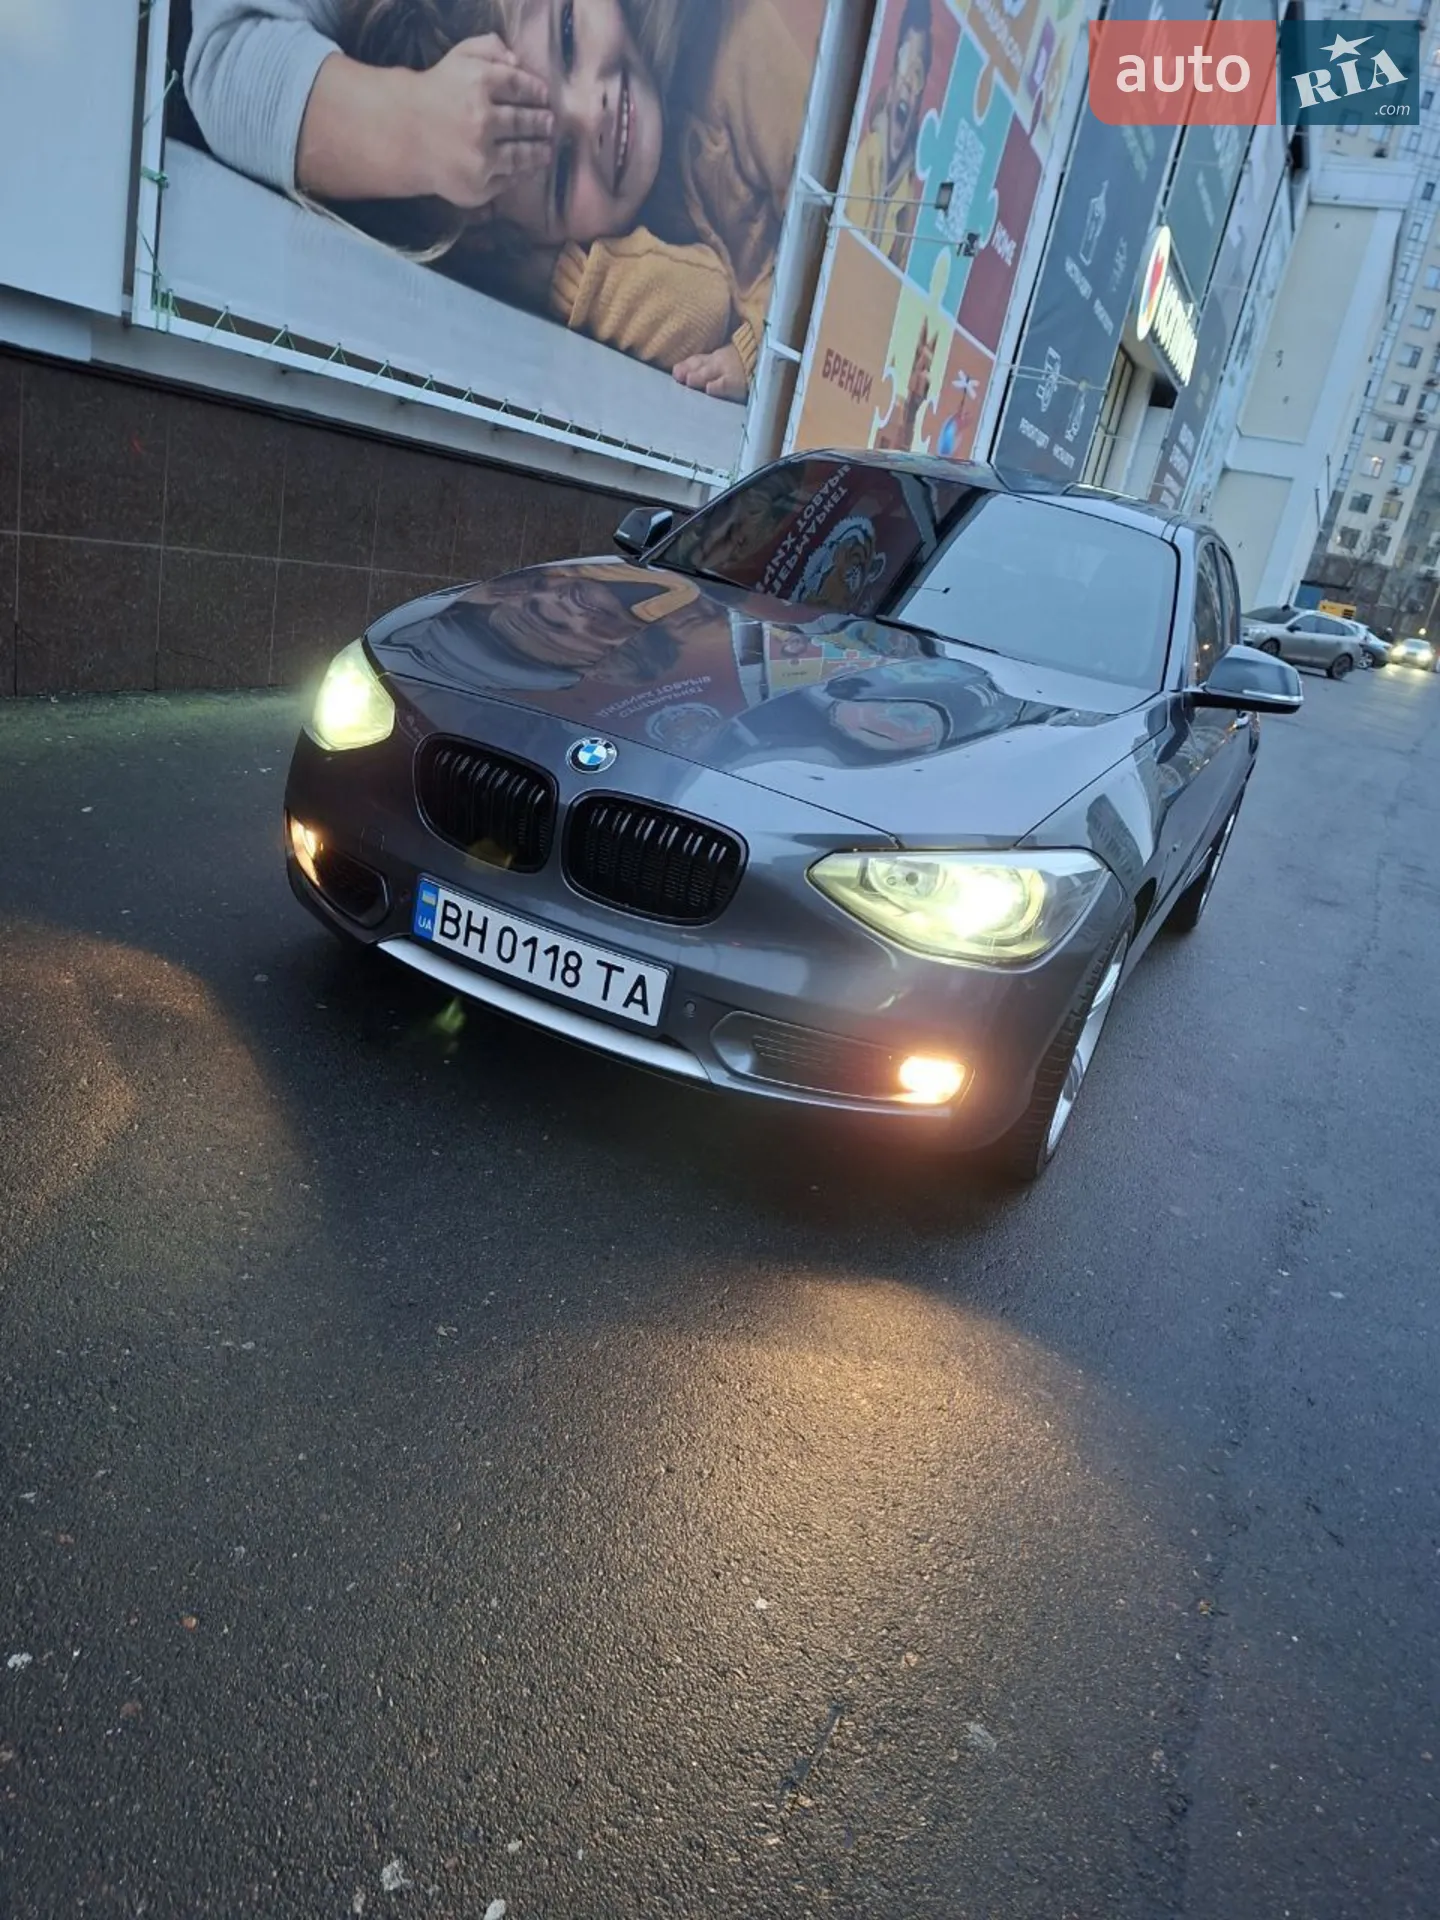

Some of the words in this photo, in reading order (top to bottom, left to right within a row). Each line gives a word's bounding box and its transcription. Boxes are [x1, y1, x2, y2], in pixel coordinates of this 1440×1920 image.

[822, 347, 873, 404] БРЕНДИ
[418, 915, 432, 931] UA
[439, 899, 489, 954] BH
[495, 926, 583, 988] 0118
[597, 959, 650, 1016] TA
